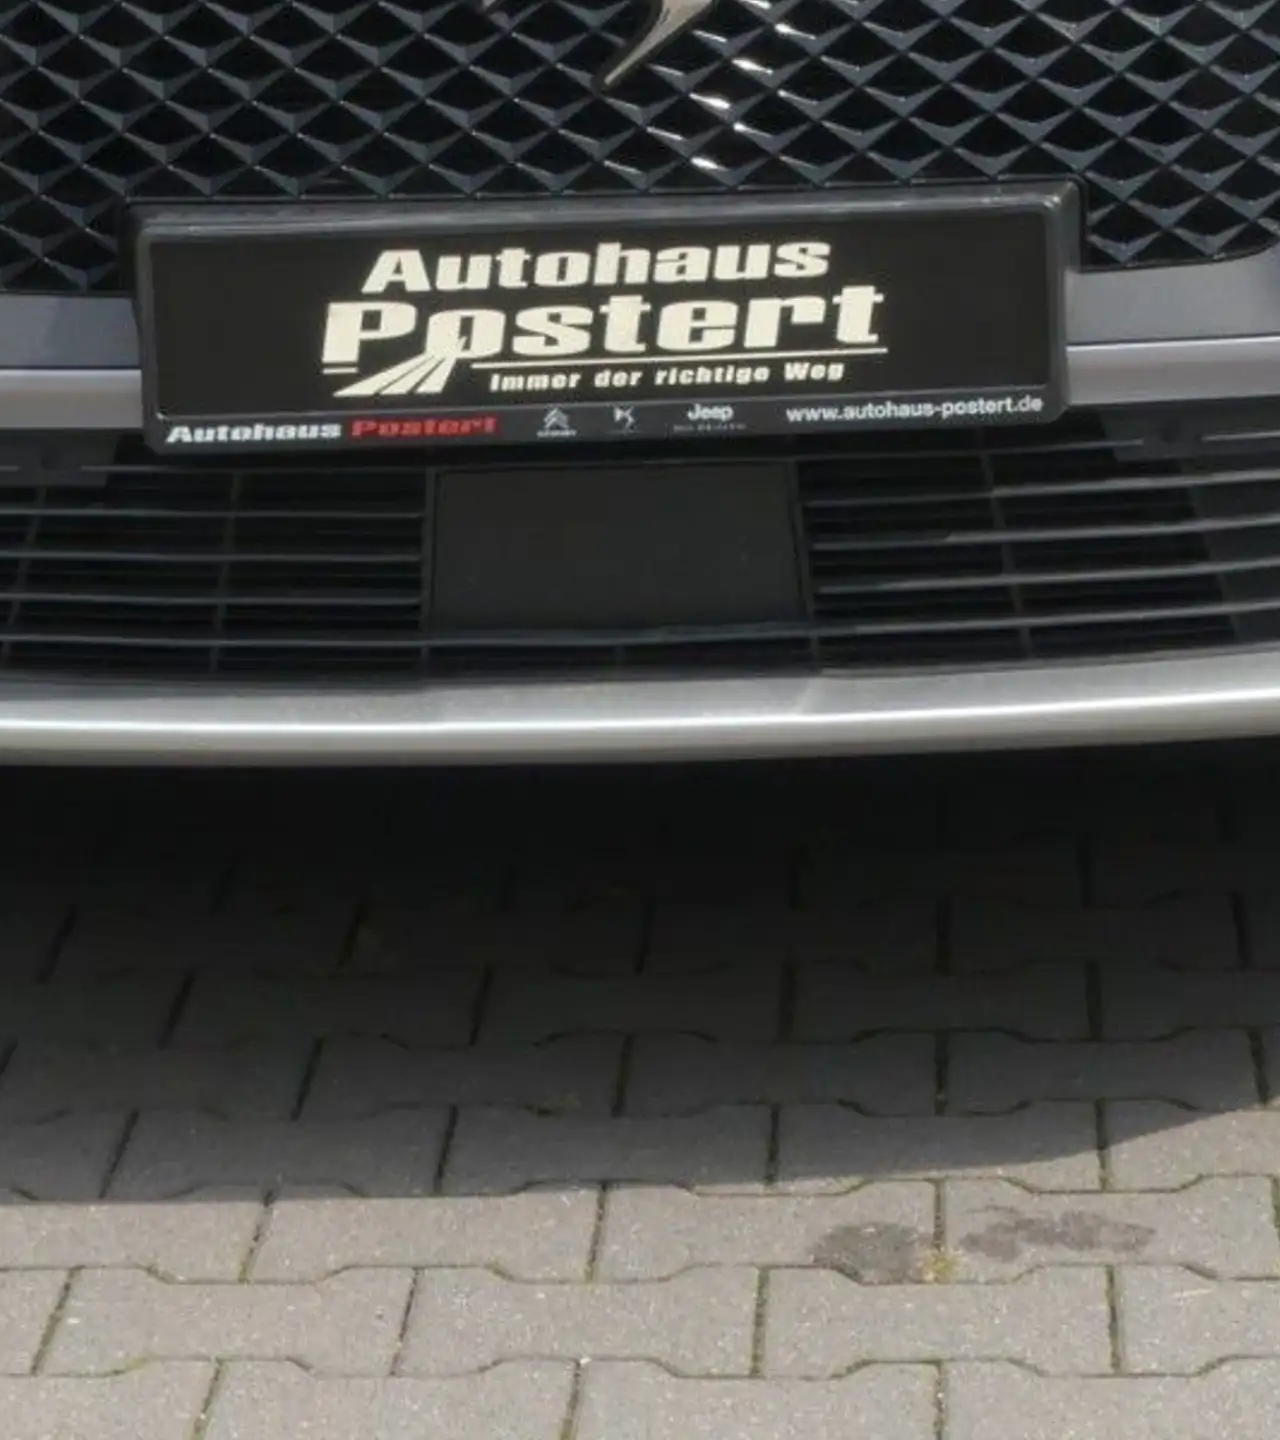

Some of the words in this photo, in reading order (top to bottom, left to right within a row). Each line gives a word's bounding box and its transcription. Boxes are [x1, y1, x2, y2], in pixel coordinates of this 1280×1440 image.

[361, 241, 831, 294] Autohaus
[321, 285, 886, 368] Postert
[592, 368, 642, 389] der
[654, 364, 771, 386] richtige
[783, 361, 845, 382] Weg
[686, 402, 735, 422] Jeep
[786, 393, 1043, 422] www.autohaus-postert.de
[166, 424, 341, 443] Autohaus
[351, 415, 498, 438] Postert
